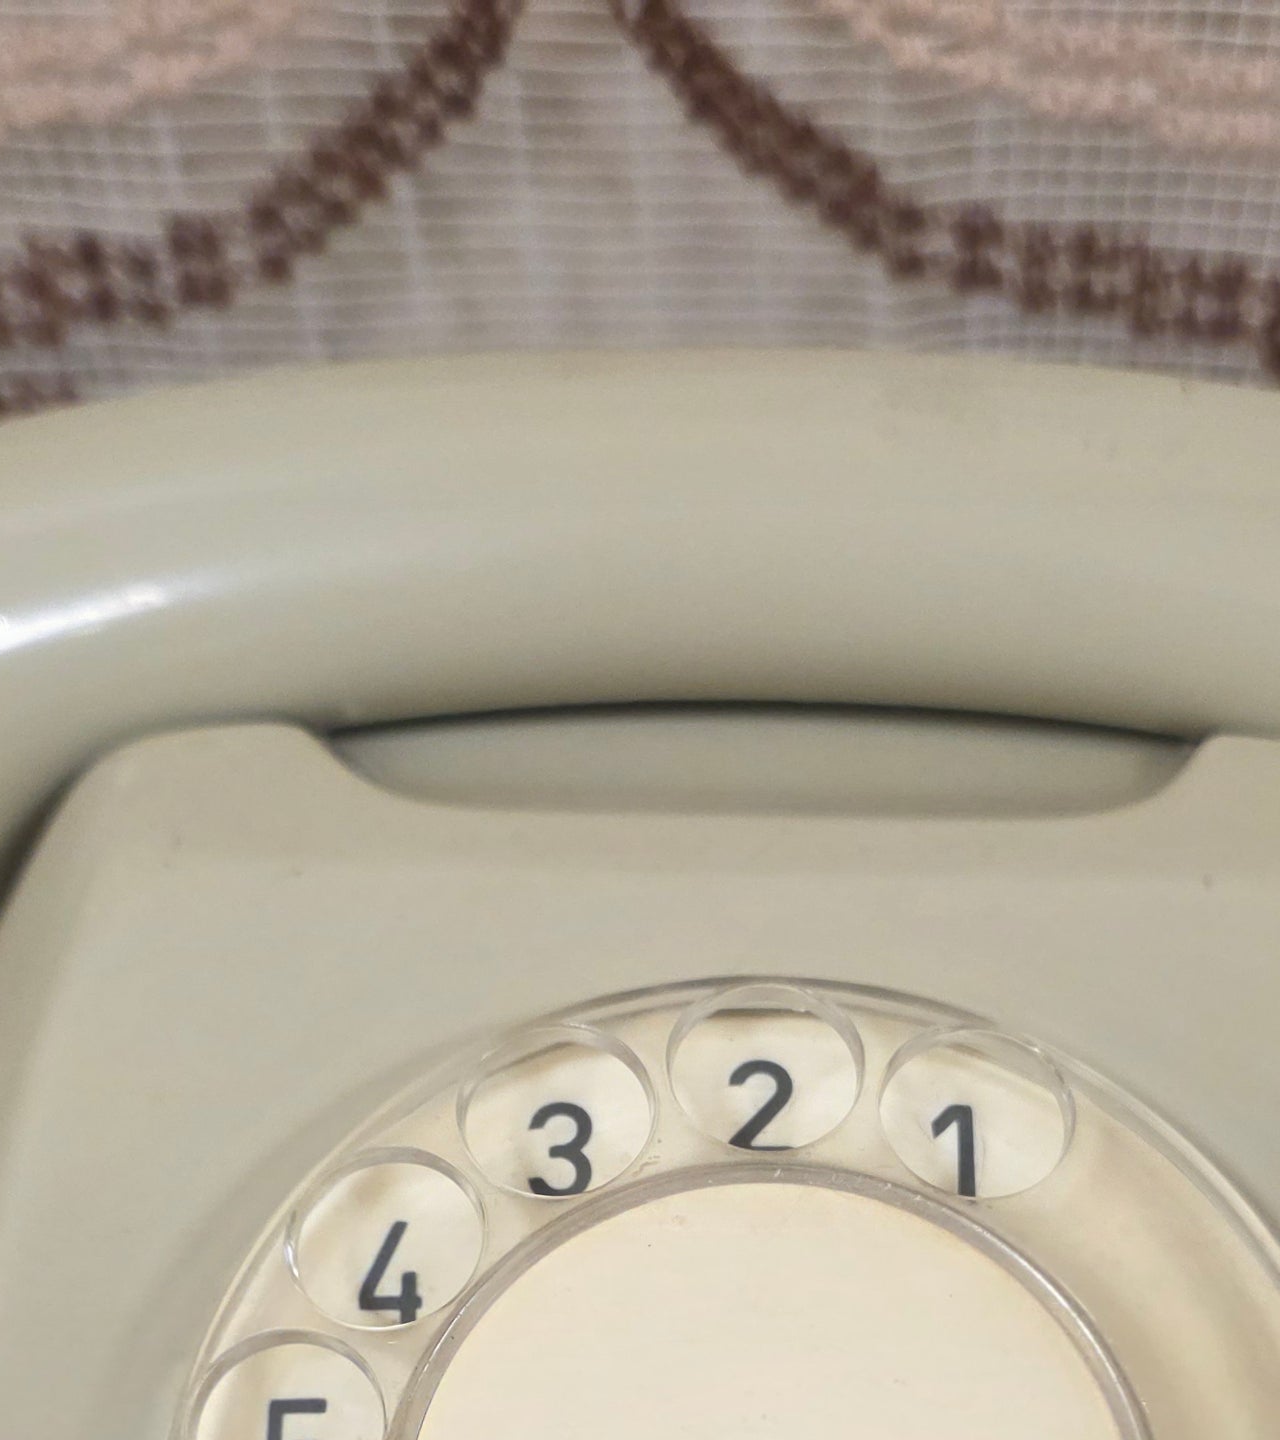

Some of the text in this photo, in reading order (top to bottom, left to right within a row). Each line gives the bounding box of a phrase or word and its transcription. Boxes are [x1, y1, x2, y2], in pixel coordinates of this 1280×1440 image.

[527, 1102, 592, 1196] 3
[728, 1060, 794, 1154] 2
[932, 1105, 976, 1197] 1
[358, 1221, 422, 1324] 4
